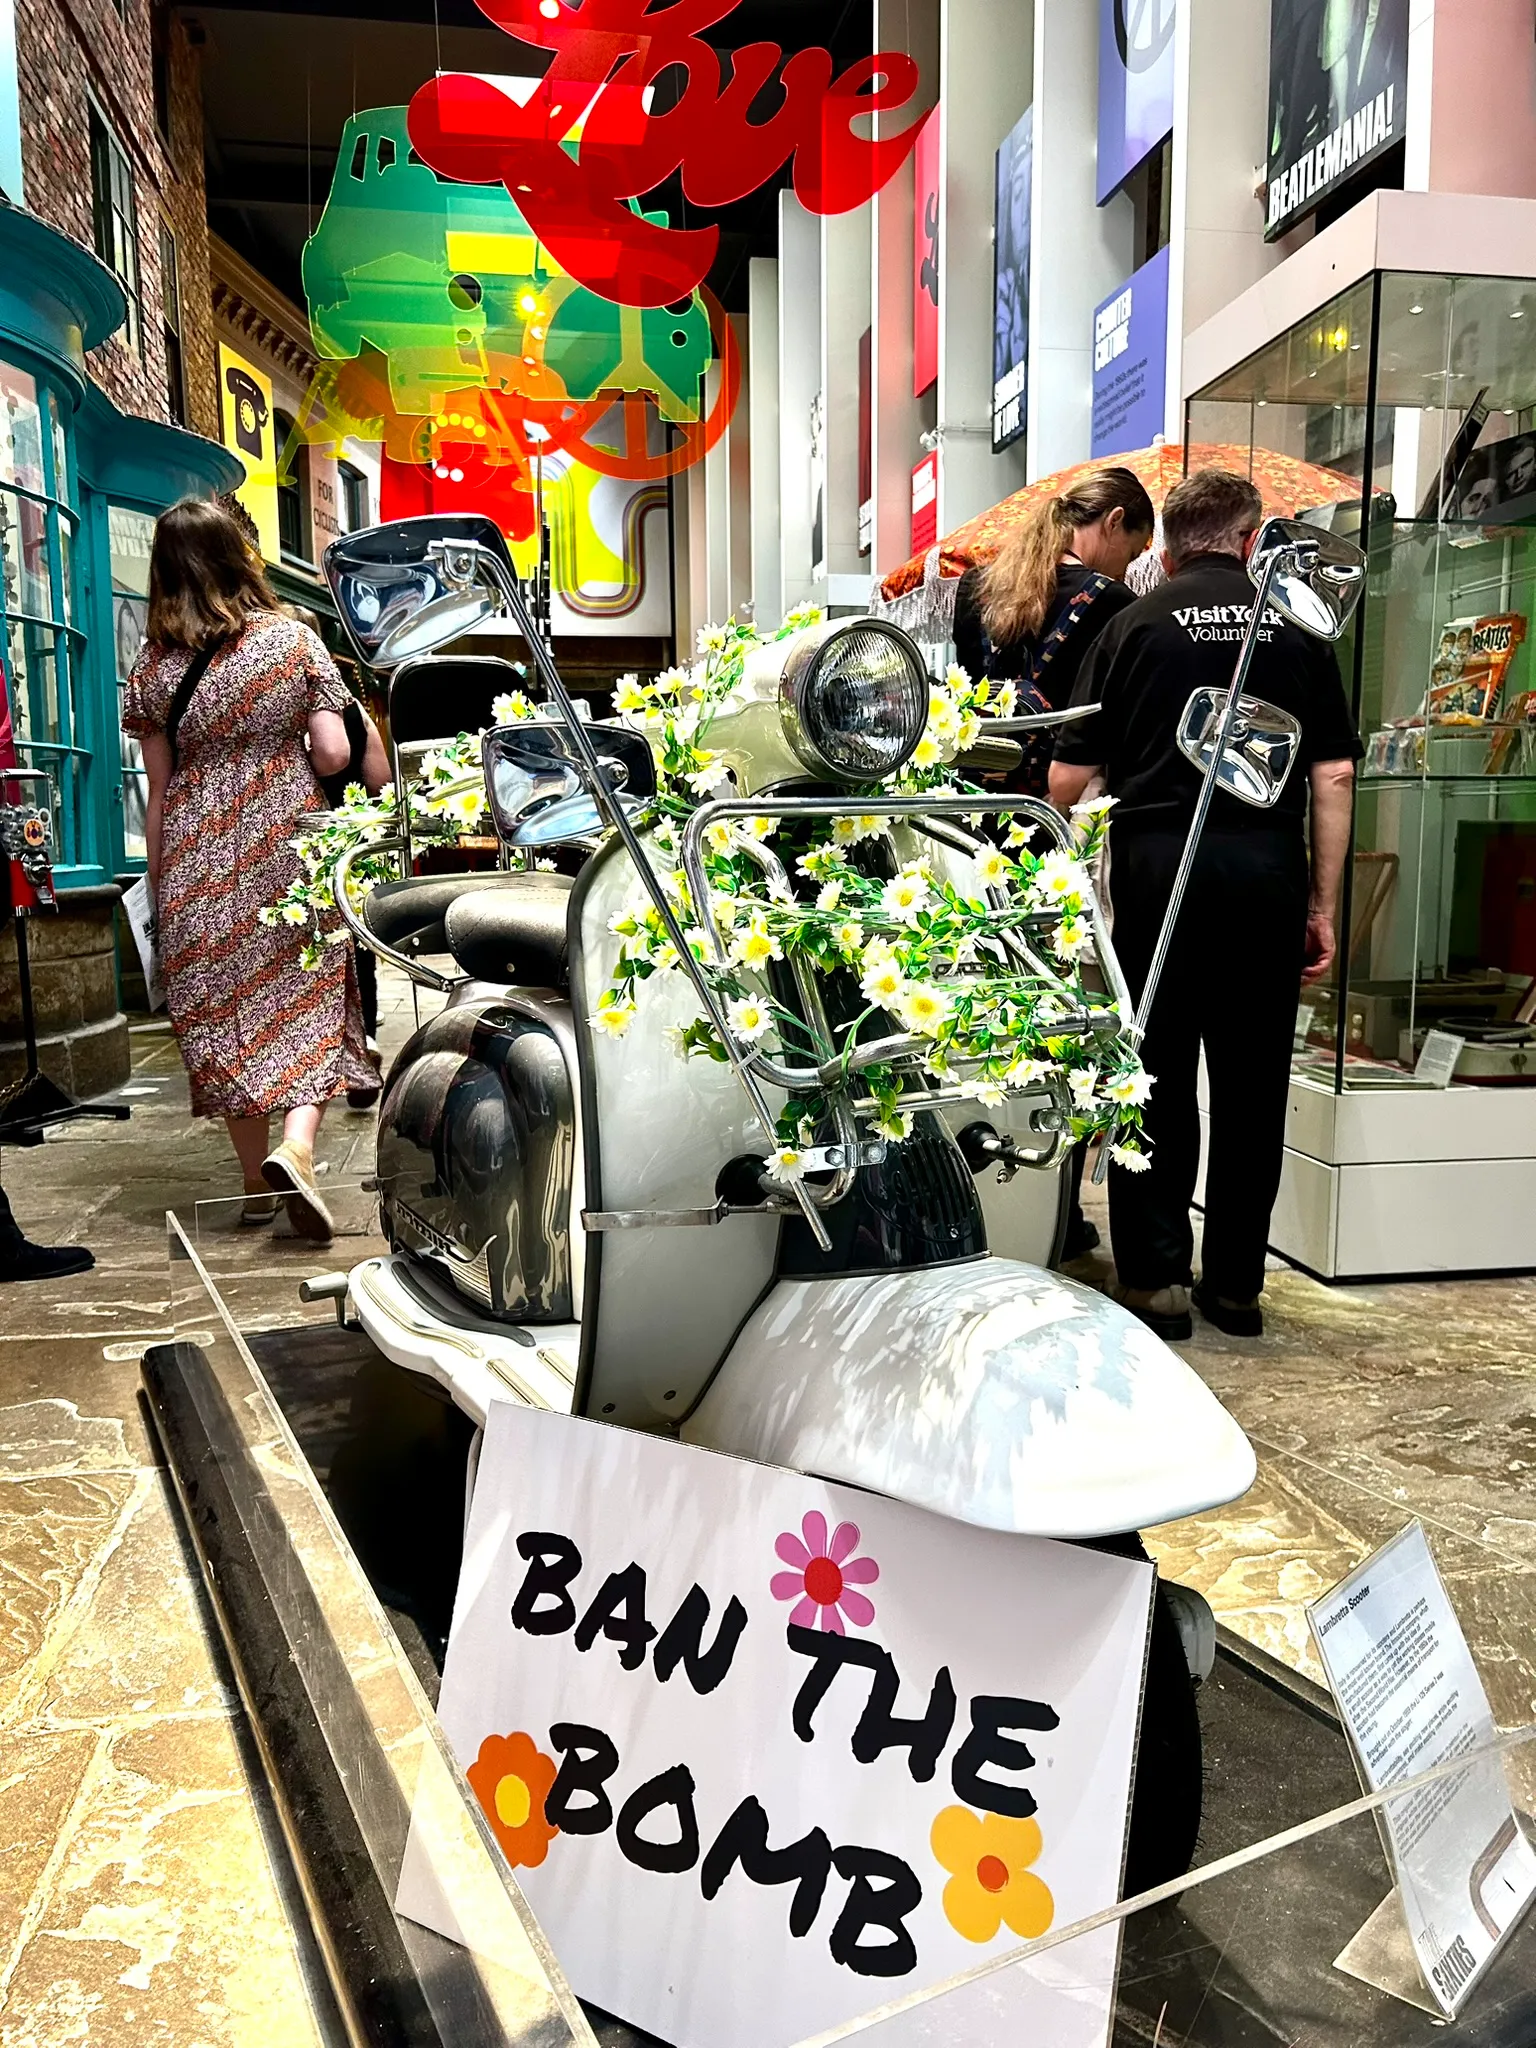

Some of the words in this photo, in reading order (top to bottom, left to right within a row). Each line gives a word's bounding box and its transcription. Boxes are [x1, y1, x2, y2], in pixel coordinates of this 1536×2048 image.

[408, 0, 933, 310] Love
[1268, 83, 1394, 228] BEATLEMANIA!
[1187, 626, 1275, 643] Volunter
[1472, 625, 1512, 654] BEATLES
[1318, 1606, 1349, 1637] Lambretta
[1347, 1585, 1371, 1611] Scooter
[511, 1531, 748, 1696] BAN
[786, 1624, 1060, 1819] THE
[544, 1722, 923, 1978] BOMB
[1432, 1934, 1477, 2001] SIXTIES
